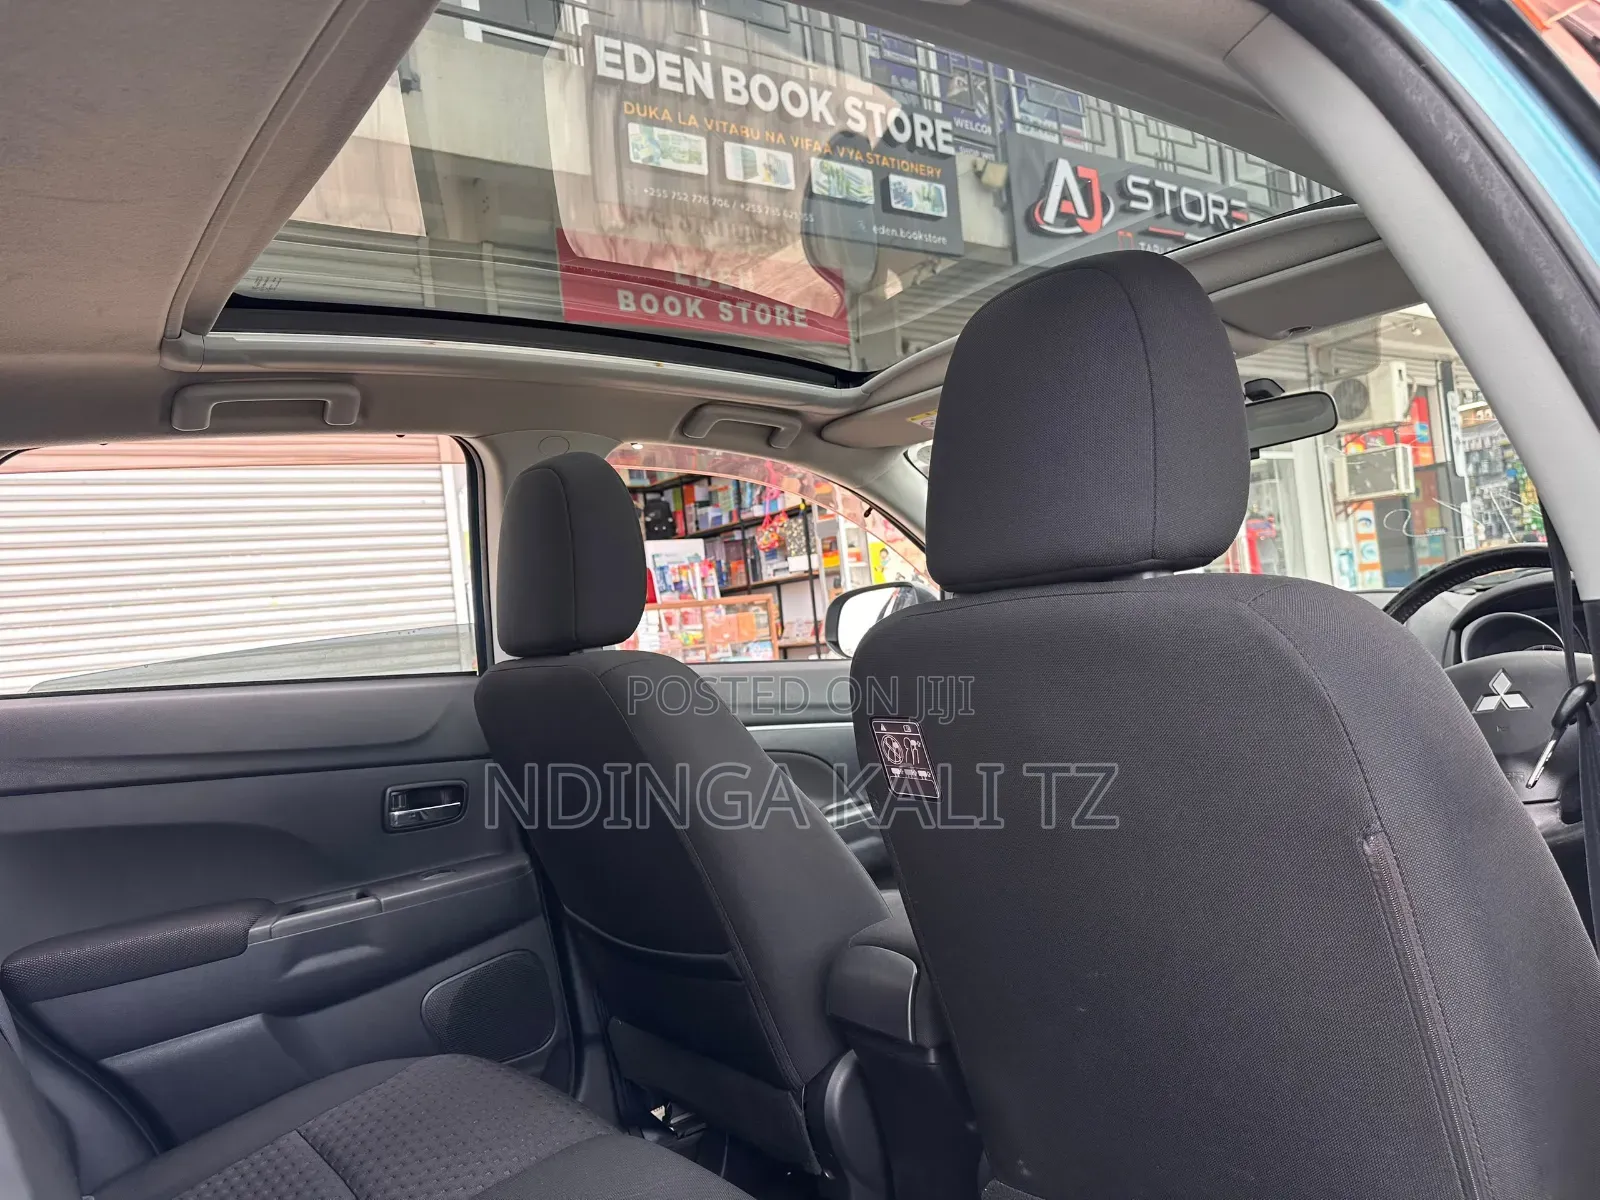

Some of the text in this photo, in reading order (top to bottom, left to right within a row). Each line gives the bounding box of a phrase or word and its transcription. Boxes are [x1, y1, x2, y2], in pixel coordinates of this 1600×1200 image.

[594, 34, 715, 100] EDEN
[721, 65, 835, 127] BOOK
[844, 96, 956, 155] STORE
[623, 101, 943, 179] DUKA LA VITABU NA VIFAA VYA STATIONERY
[643, 186, 669, 200] +255
[1043, 157, 1248, 234] AJ STORE
[872, 223, 948, 246] eden.bookstore
[617, 289, 808, 328] BOOK STORE
